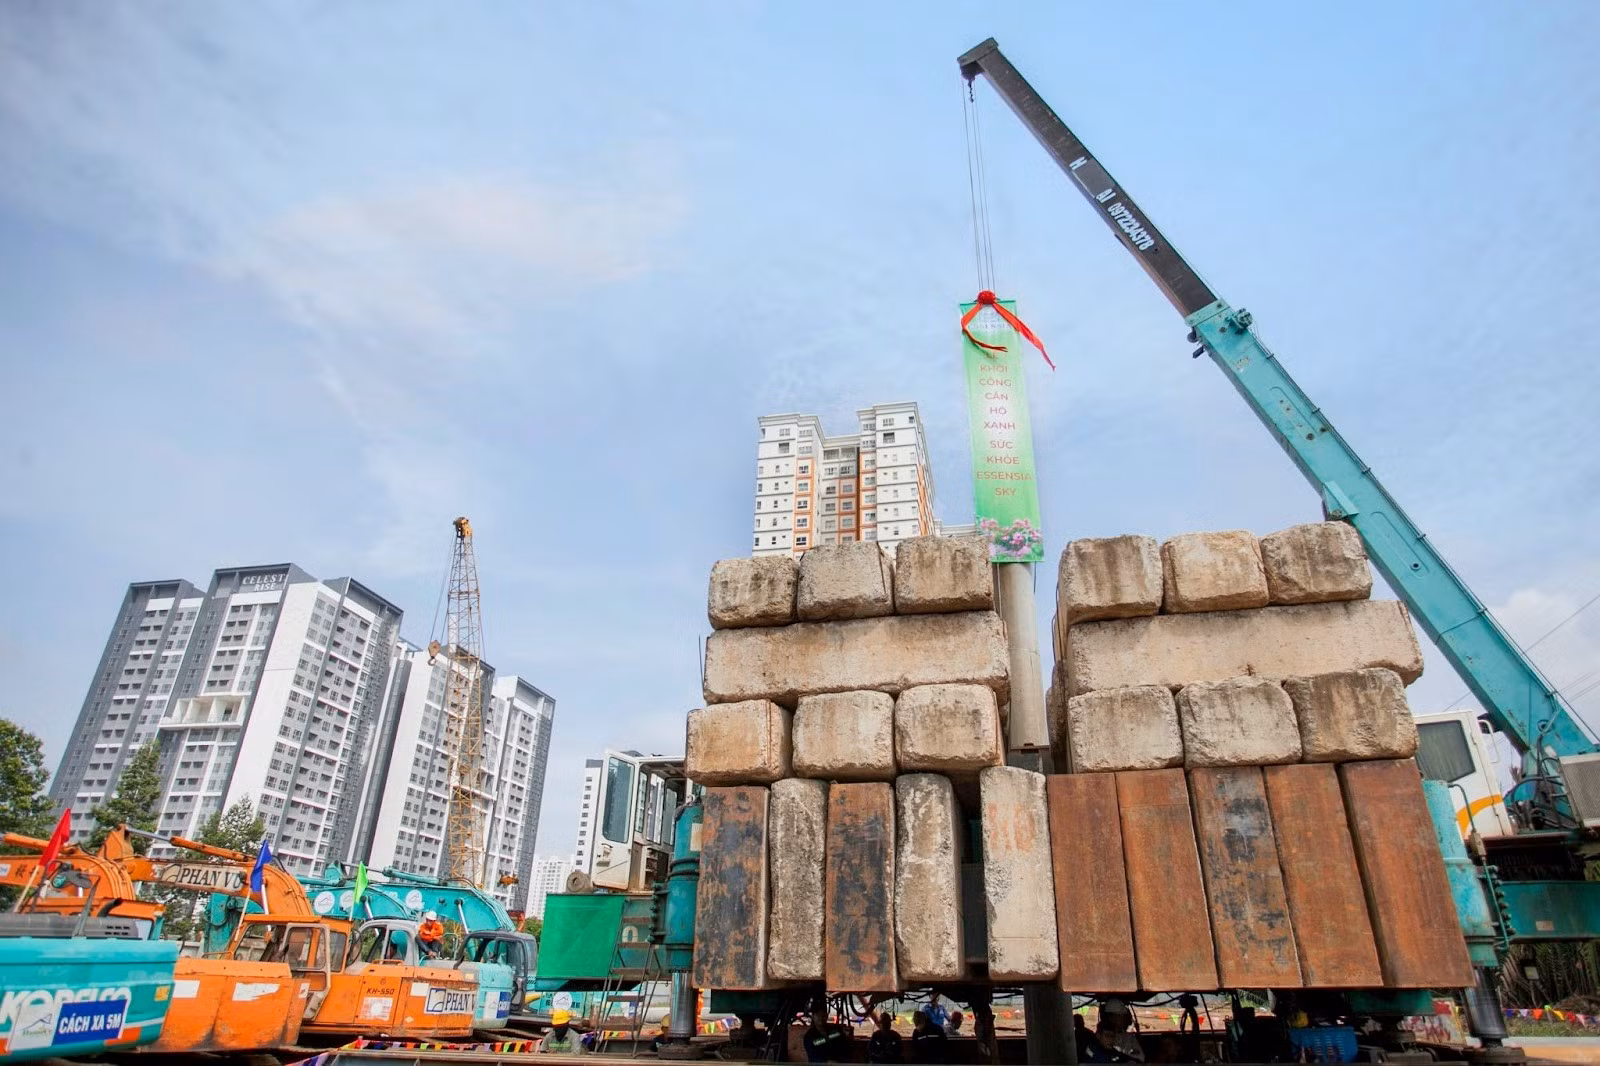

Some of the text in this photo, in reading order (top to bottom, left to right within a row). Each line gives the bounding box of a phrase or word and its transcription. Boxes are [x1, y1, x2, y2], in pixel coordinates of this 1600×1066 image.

[983, 421, 1016, 430] XANH
[976, 471, 1033, 481] ESSENSIA
[994, 487, 1017, 496] SKY
[242, 574, 285, 585] CELEST
[254, 583, 276, 591] RISE
[178, 867, 222, 886] PHAN
[445, 992, 470, 1012] PHAN
[58, 1012, 91, 1035] CÁCH
[91, 1013, 105, 1031] XA
[106, 1012, 122, 1030] 5M
